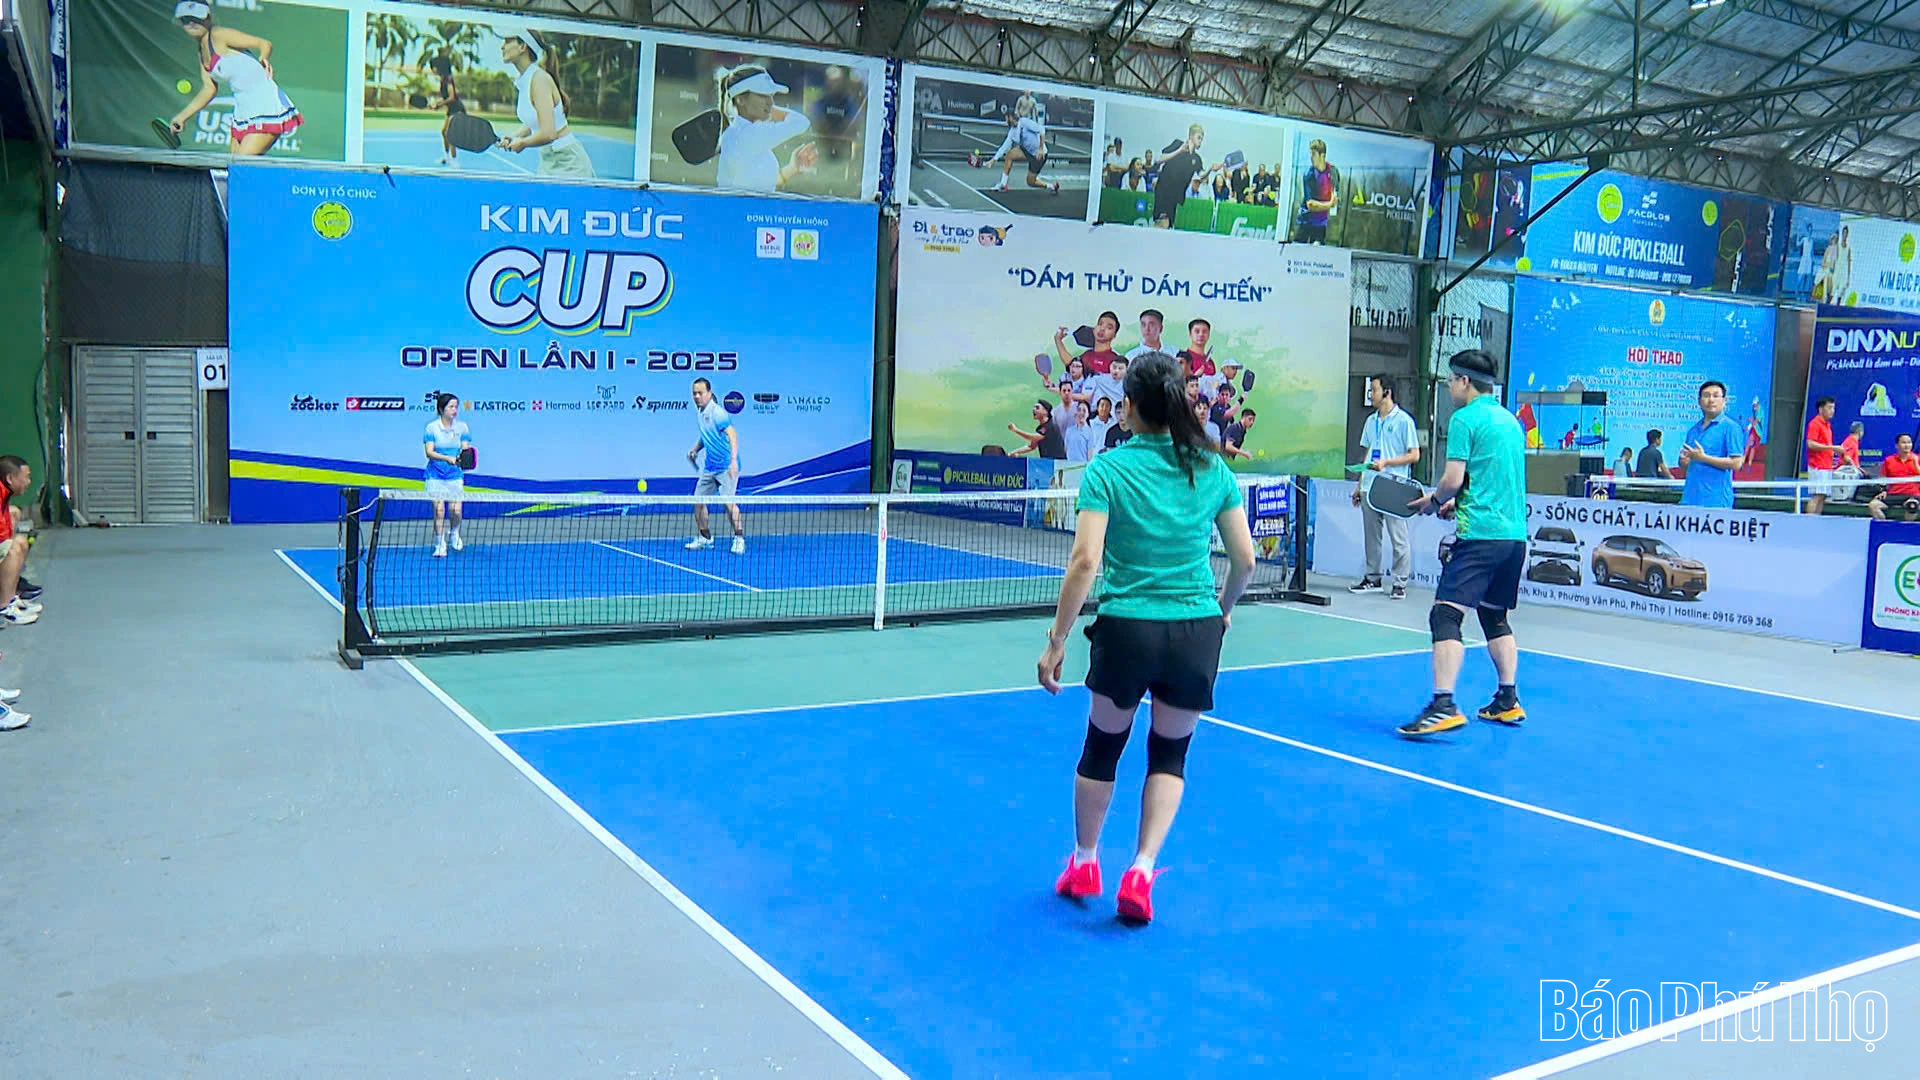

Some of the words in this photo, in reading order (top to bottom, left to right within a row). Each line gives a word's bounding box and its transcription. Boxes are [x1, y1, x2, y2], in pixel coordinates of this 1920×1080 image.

[1366, 192, 1416, 211] JOOLA
[480, 204, 569, 234] KIM
[582, 206, 684, 241] ĐỨC
[942, 224, 974, 237] trao
[1573, 230, 1596, 255] KIM
[1598, 231, 1621, 257] ĐỨC
[1623, 236, 1686, 266] PICKLEBALL
[465, 245, 674, 336] CUP
[1142, 273, 1190, 297] DÁM
[1438, 314, 1464, 341] VIỆT
[1468, 318, 1493, 340] NAM
[400, 346, 507, 369] OPEN
[648, 350, 737, 371] 2025
[204, 363, 226, 381] 01
[290, 398, 339, 411] zocker
[361, 399, 403, 410] LOTTO
[474, 400, 526, 411] EASTROC
[952, 471, 991, 485] PICKLEBALL
[992, 473, 1006, 487] KIM
[1007, 473, 1024, 488] ĐỨC
[1545, 501, 1588, 523] SỐNG
[1593, 506, 1640, 529] CHẤT,
[1645, 510, 1670, 531] LÁI
[1675, 514, 1726, 535] KHÁC
[1730, 517, 1770, 542] BIỆT
[1532, 587, 1548, 599] Khu
[1558, 590, 1590, 606] Phường
[1649, 602, 1665, 616] Thọ
[1674, 606, 1710, 621] Hotline:
[1712, 611, 1734, 623] 0916
[1737, 613, 1754, 625] 769
[1755, 616, 1773, 628] 368
